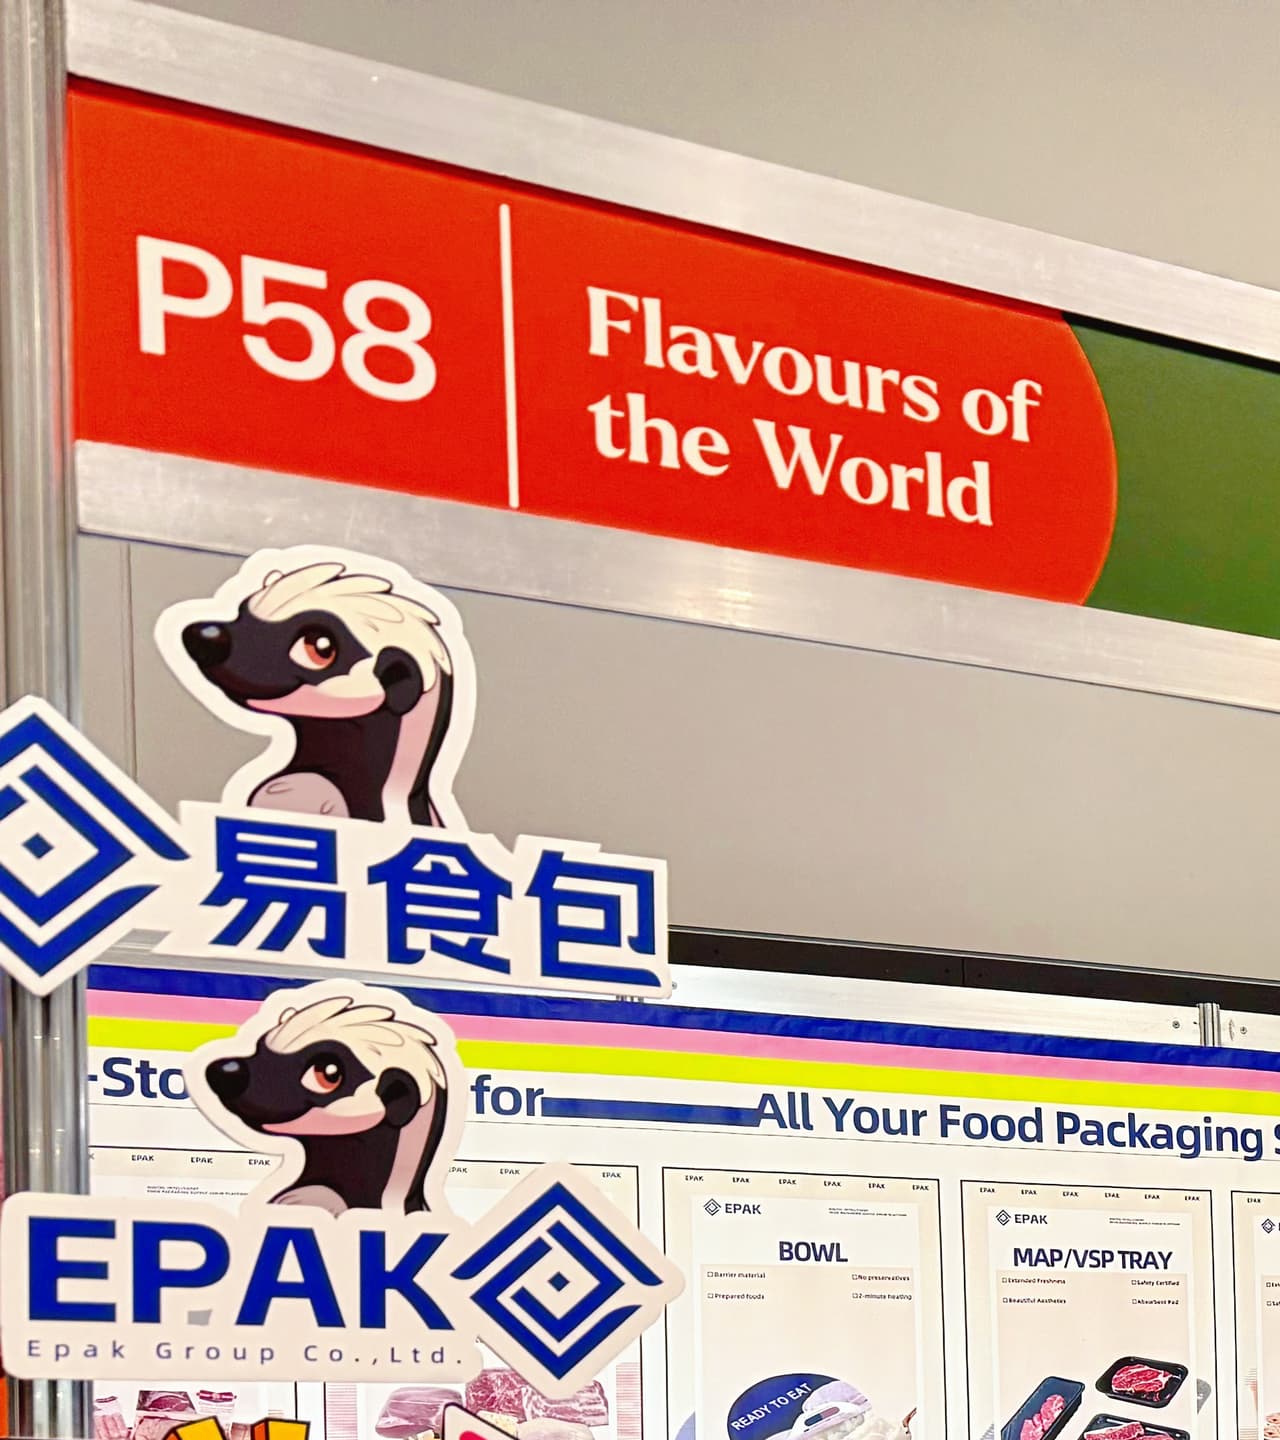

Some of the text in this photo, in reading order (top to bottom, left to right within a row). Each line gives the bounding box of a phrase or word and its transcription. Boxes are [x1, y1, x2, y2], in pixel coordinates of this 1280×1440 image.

[136, 235, 438, 402] P58
[586, 284, 1042, 444] Flavours of
[589, 393, 993, 528] the World
[200, 815, 662, 988] 易食包
[470, 1076, 544, 1116] for
[757, 1092, 813, 1131] All
[823, 1096, 927, 1138] Your
[939, 1104, 1042, 1145] Food
[1056, 1112, 1263, 1162] Packaging
[725, 1202, 761, 1215] EPAK
[779, 1241, 848, 1264] BOWL
[28, 1216, 456, 1331] EPAK
[1013, 1247, 1172, 1271] MAP/VSP TRAY
[27, 1339, 462, 1367] Epak Group Co.,Ltd.
